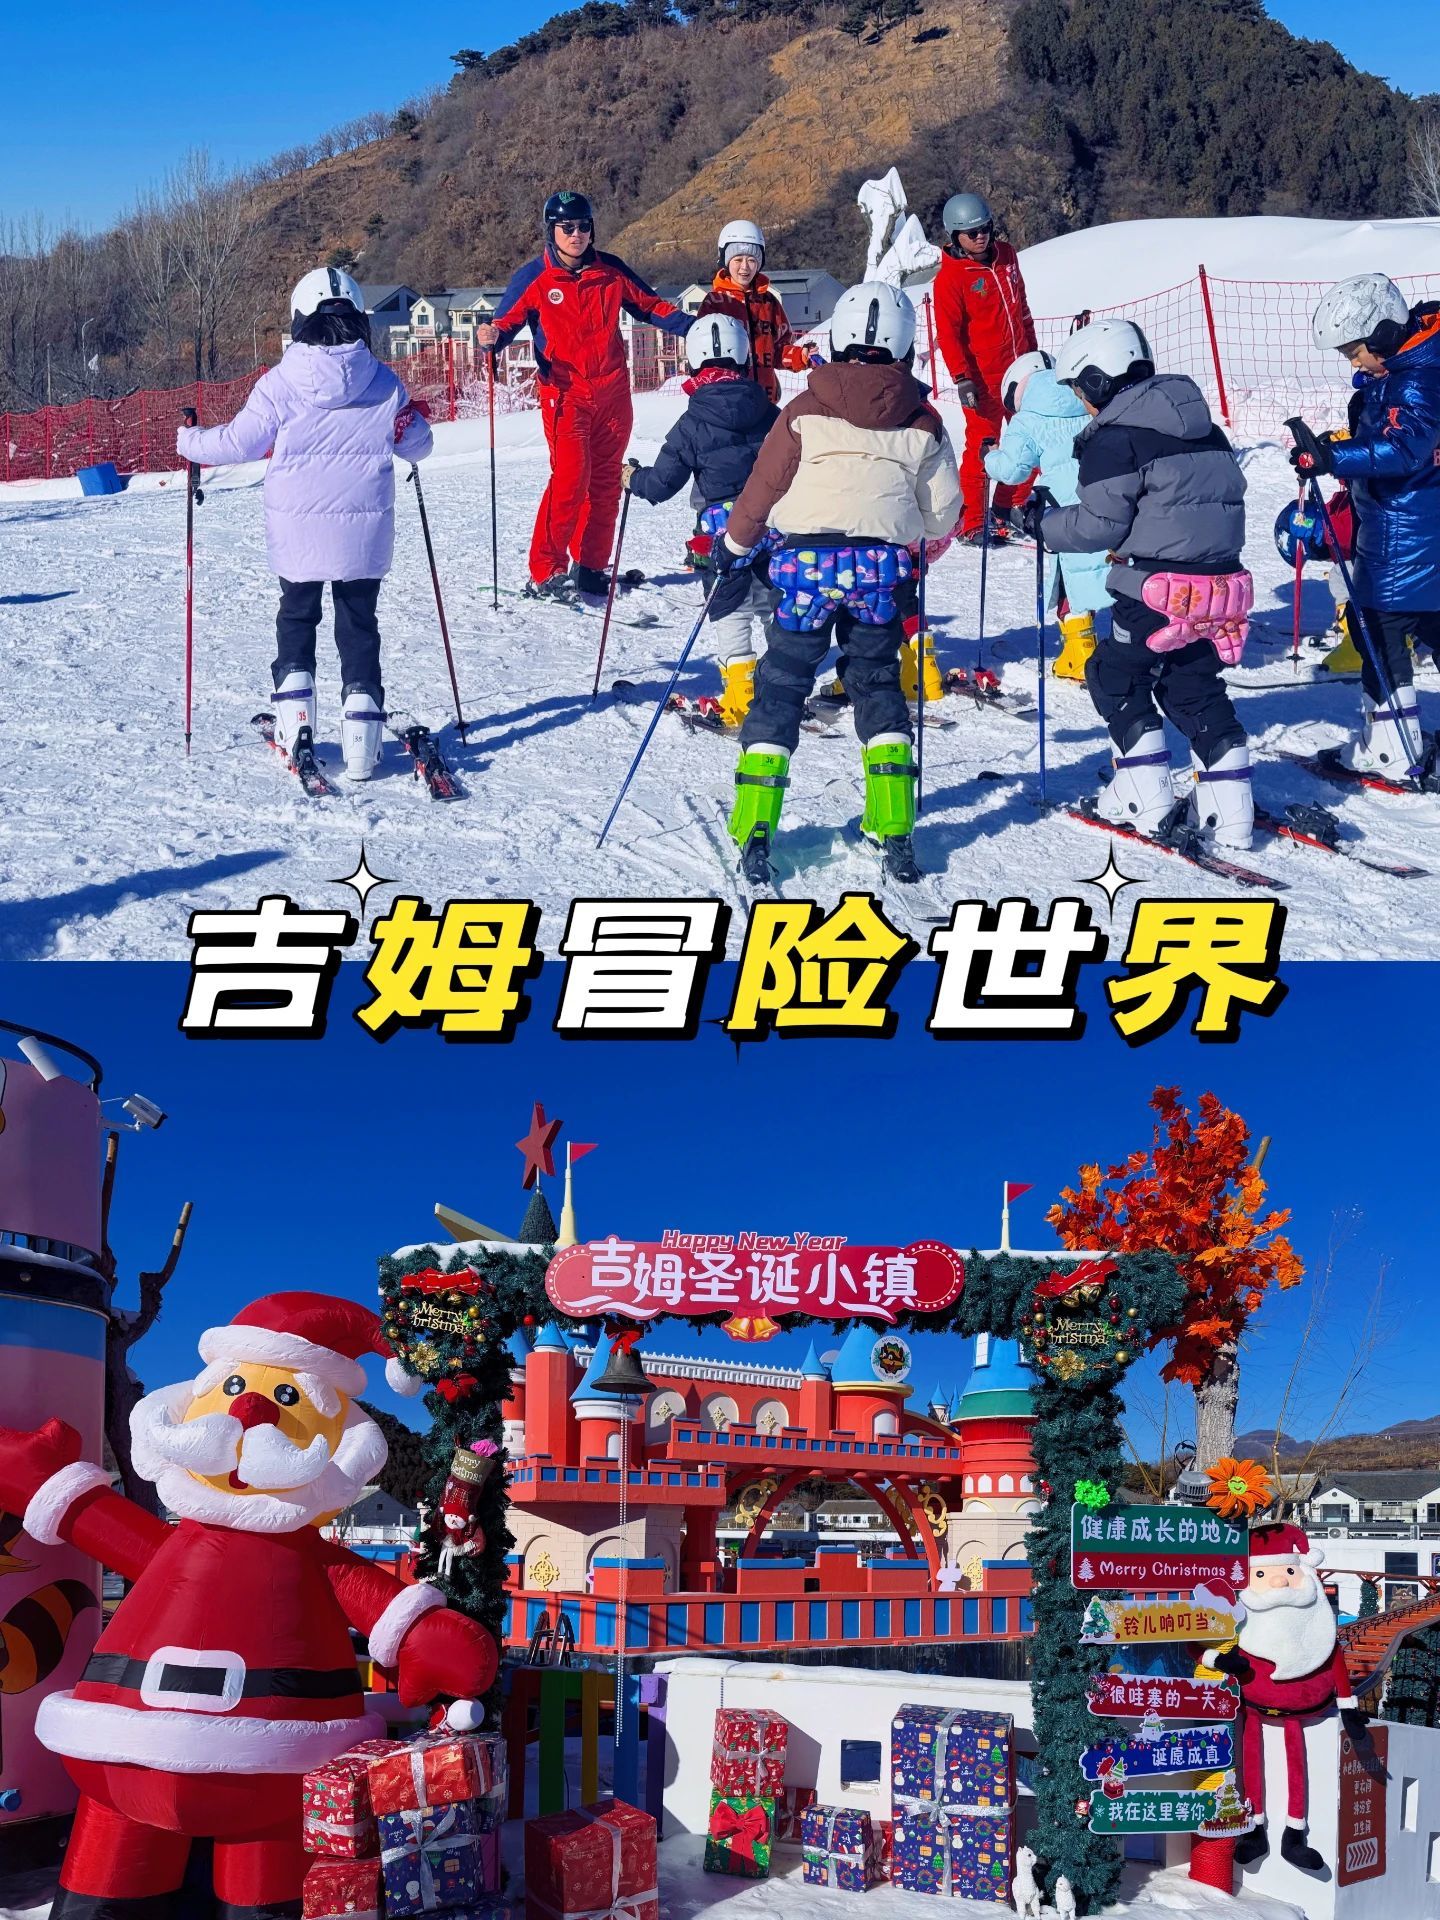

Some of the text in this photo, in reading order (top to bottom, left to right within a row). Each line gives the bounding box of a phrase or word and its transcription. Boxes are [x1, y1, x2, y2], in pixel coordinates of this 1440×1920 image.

[298, 711, 306, 722] 35
[765, 756, 774, 765] 36
[889, 745, 899, 754] 36
[661, 1229, 848, 1253] Happy New Year
[589, 1237, 919, 1307] 吉姆圣诞小镇
[418, 1300, 465, 1323] Merry
[1054, 1317, 1105, 1335] Merry
[1080, 1514, 1241, 1545] 健康成长的地方
[1099, 1561, 1226, 1580] Merry Christmas
[1123, 1612, 1209, 1636] 铃儿响叮当
[1109, 1685, 1216, 1711] 很哇塞的一天
[1152, 1745, 1220, 1767] 诞愿成真
[1108, 1801, 1206, 1822] 我在这里等你
